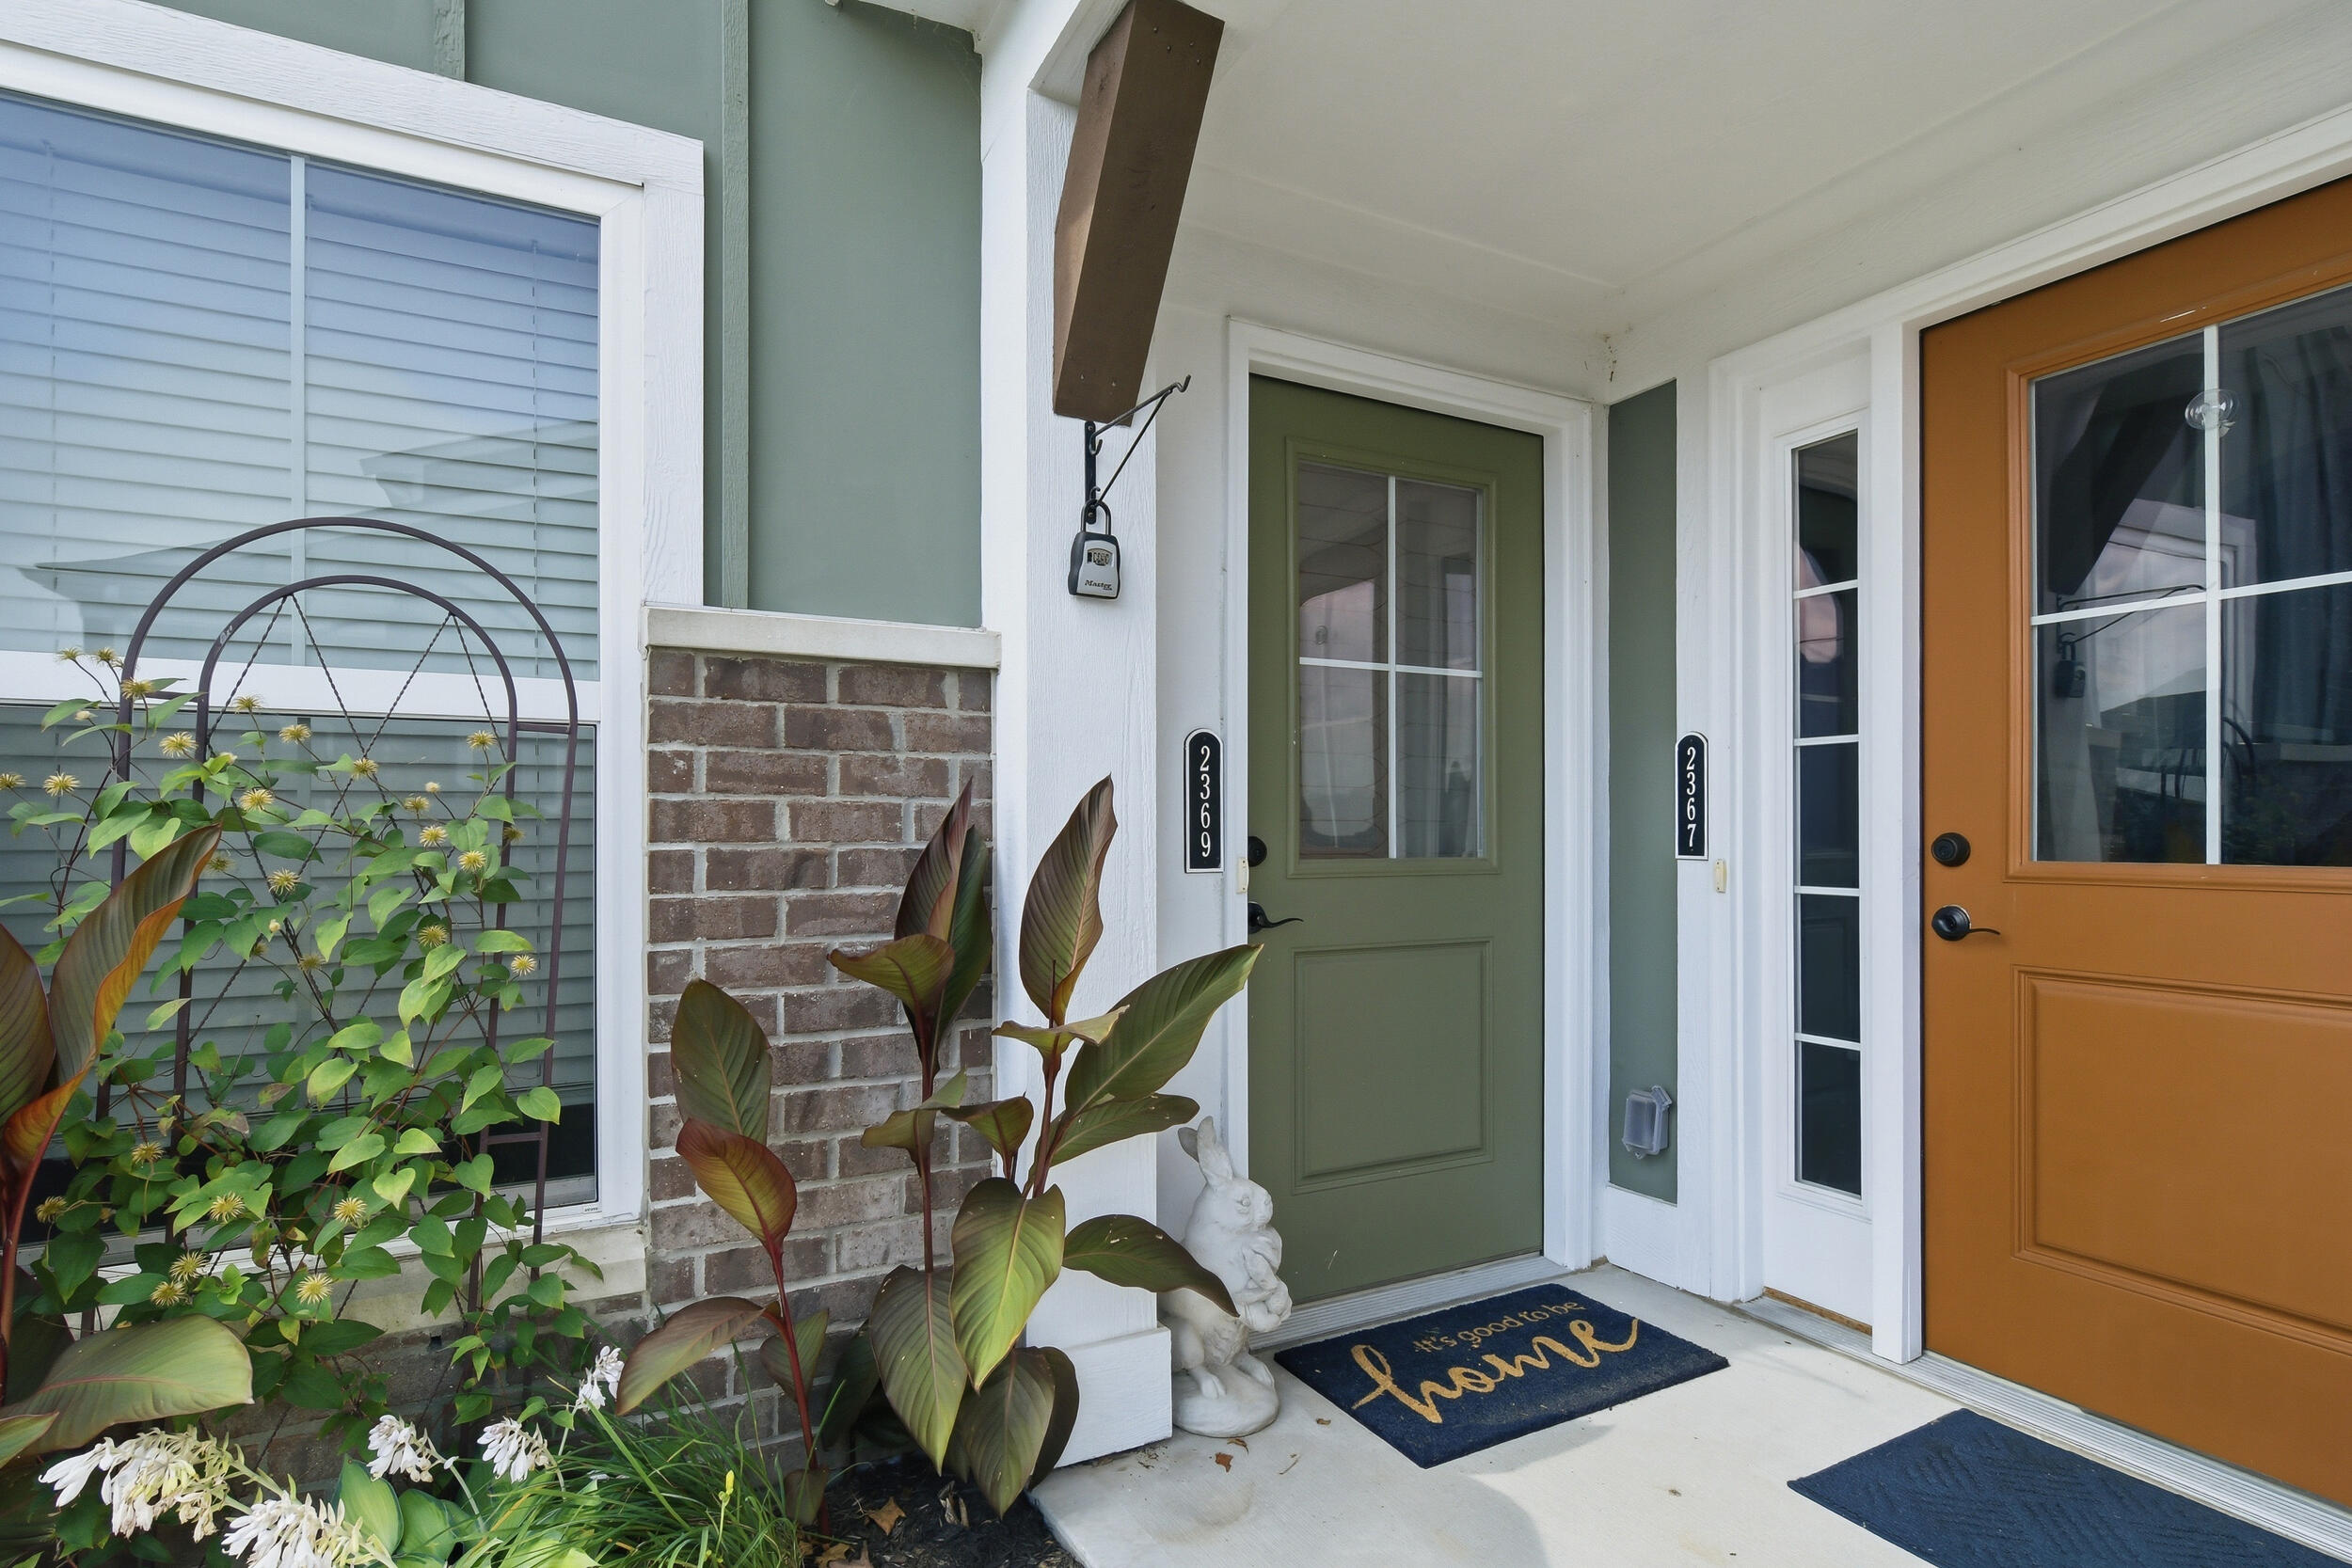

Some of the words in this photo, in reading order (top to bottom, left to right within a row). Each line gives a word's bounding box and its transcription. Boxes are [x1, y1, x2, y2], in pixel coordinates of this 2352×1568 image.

[1085, 579, 1112, 589] Master
[1200, 745, 1211, 858] 2369
[1686, 746, 1696, 847] 2367
[1351, 1317, 1640, 1424] home
[1413, 1335, 1457, 1354] It's
[1458, 1316, 1524, 1349] good
[1518, 1310, 1549, 1323] to
[1541, 1301, 1587, 1316] be
